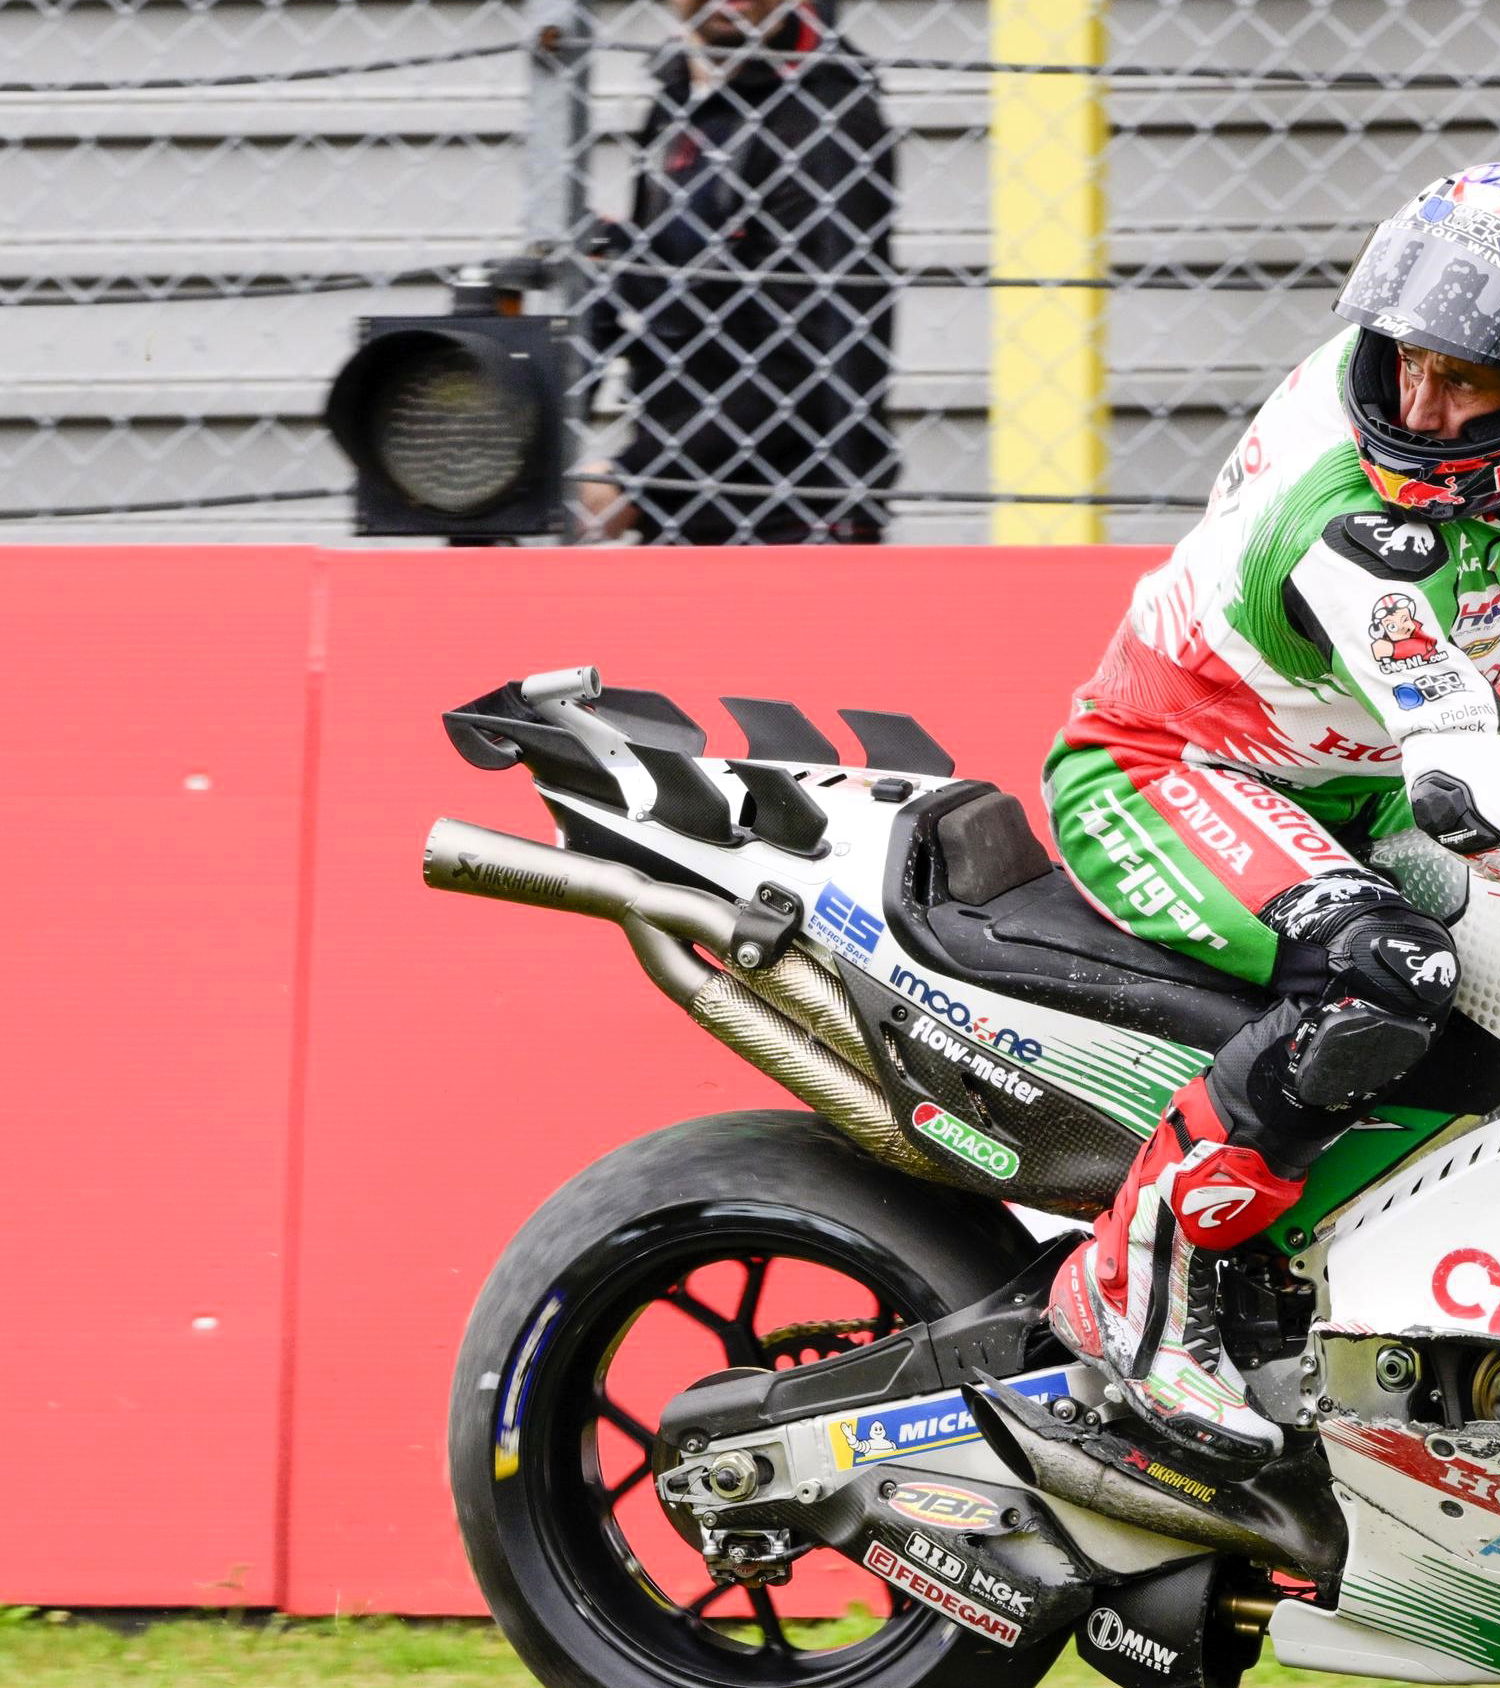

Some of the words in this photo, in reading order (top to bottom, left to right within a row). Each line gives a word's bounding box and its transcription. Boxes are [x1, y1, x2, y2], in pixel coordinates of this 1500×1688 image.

[1422, 224, 1457, 242] YOU
[809, 914, 846, 946] ENERGY
[845, 941, 872, 965] SAFE
[814, 880, 886, 954] ES
[909, 1014, 1044, 1106] flow-meter
[926, 1112, 1010, 1172] DRACO
[895, 1564, 1017, 1643] FEDEGARI
[969, 1585, 997, 1603] SPARK
[997, 1600, 1026, 1618] PLUGS
[971, 1570, 1035, 1613] NGK
[1118, 1644, 1171, 1675] FILTERS
[1122, 1628, 1179, 1667] MIW
